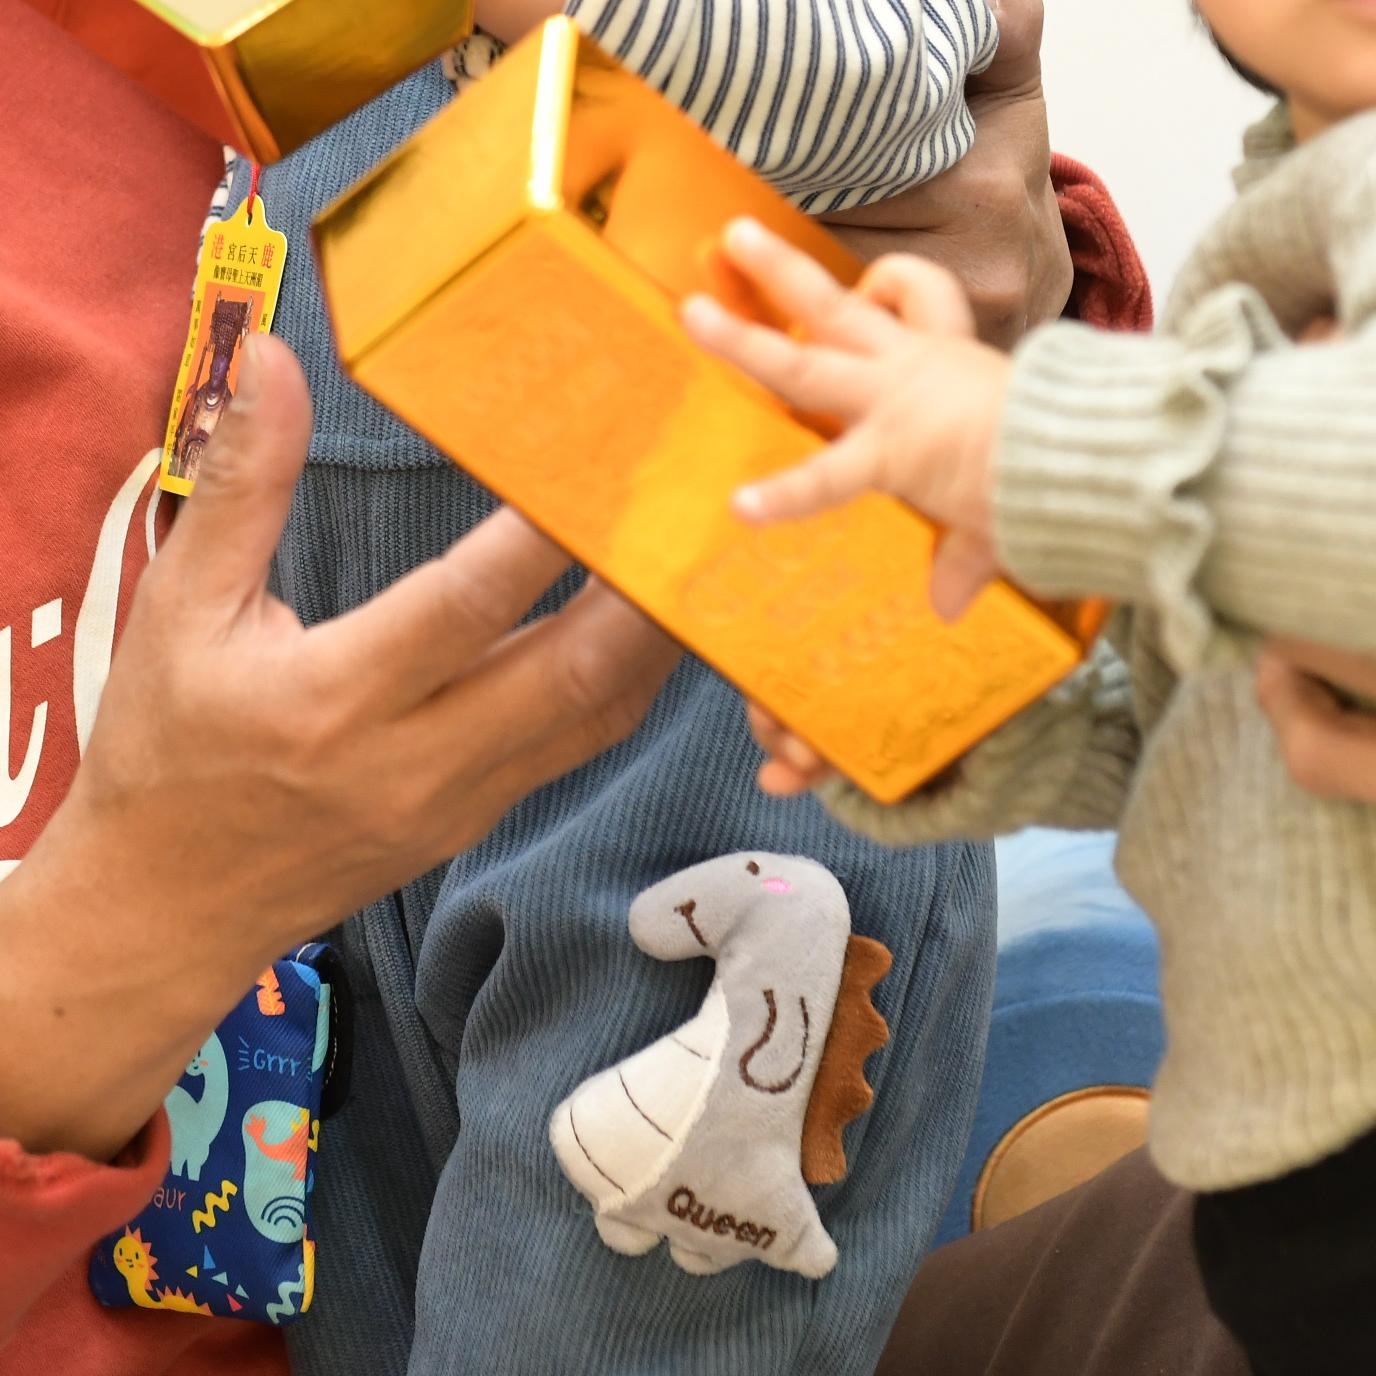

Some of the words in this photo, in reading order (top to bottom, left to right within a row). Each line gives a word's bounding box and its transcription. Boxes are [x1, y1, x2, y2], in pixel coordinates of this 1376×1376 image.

[253, 1048, 301, 1076] Grrr
[150, 1186, 187, 1212] aur
[667, 1185, 778, 1250] Queen
